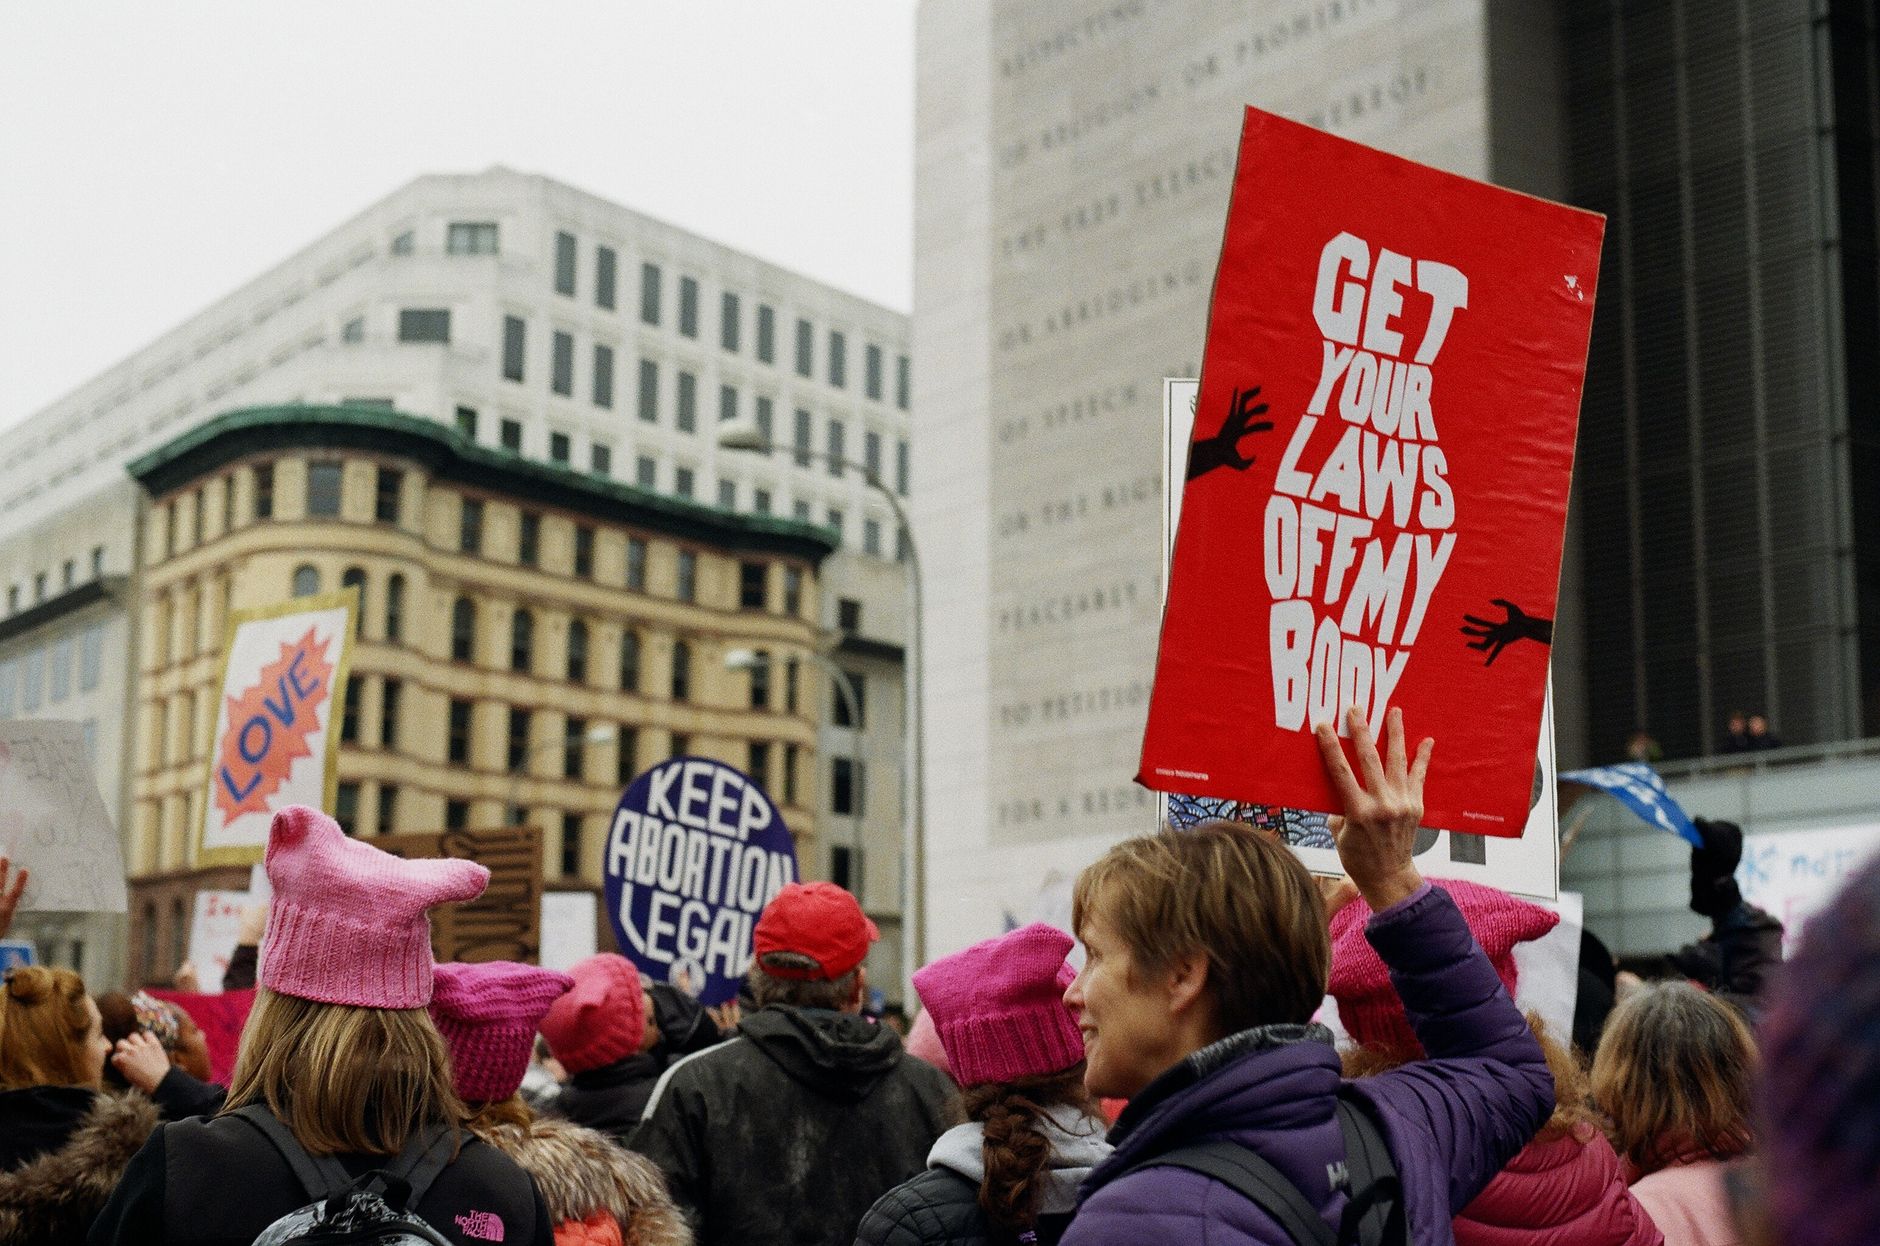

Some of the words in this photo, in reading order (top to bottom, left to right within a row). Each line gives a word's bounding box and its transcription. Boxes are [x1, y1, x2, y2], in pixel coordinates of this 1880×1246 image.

[1312, 230, 1469, 365] GET
[1306, 340, 1439, 441] YOUR
[1274, 414, 1456, 529] LAWS
[1263, 495, 1373, 605] OFF
[1340, 532, 1458, 646] MY
[1269, 598, 1411, 745] BODY
[220, 649, 321, 804] LOVE
[646, 760, 772, 842] KEEP
[607, 807, 794, 914] ABORTION
[454, 1214, 488, 1231] NORTH
[462, 1225, 487, 1239] FACE
[469, 1209, 490, 1221] THE
